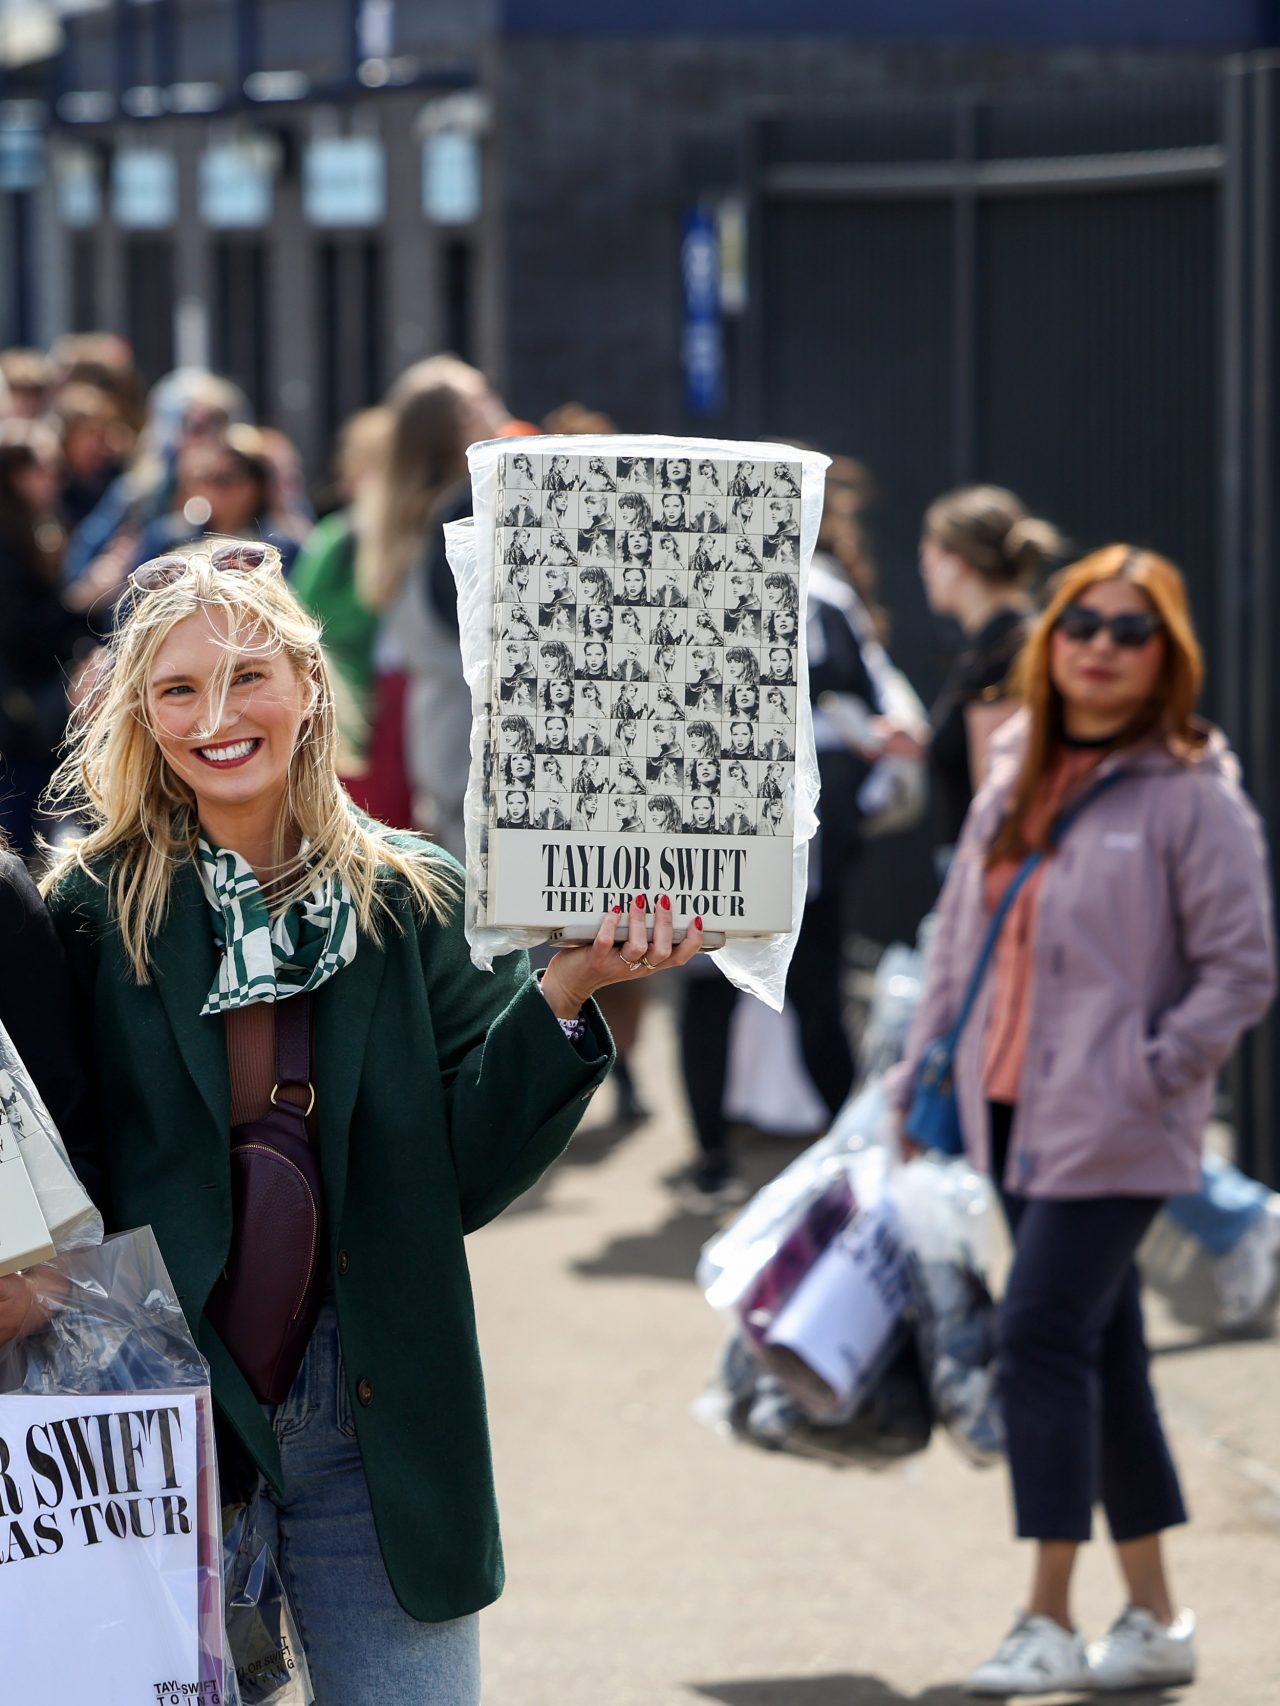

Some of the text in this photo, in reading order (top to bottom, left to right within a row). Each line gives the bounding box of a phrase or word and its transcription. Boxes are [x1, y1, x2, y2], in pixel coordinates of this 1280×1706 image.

[541, 844, 747, 893] TAYLOR SWIFT
[541, 890, 594, 912] THE
[675, 893, 745, 917] TOUR
[26, 1406, 184, 1510] SWIFT
[70, 1494, 193, 1547] TOUR
